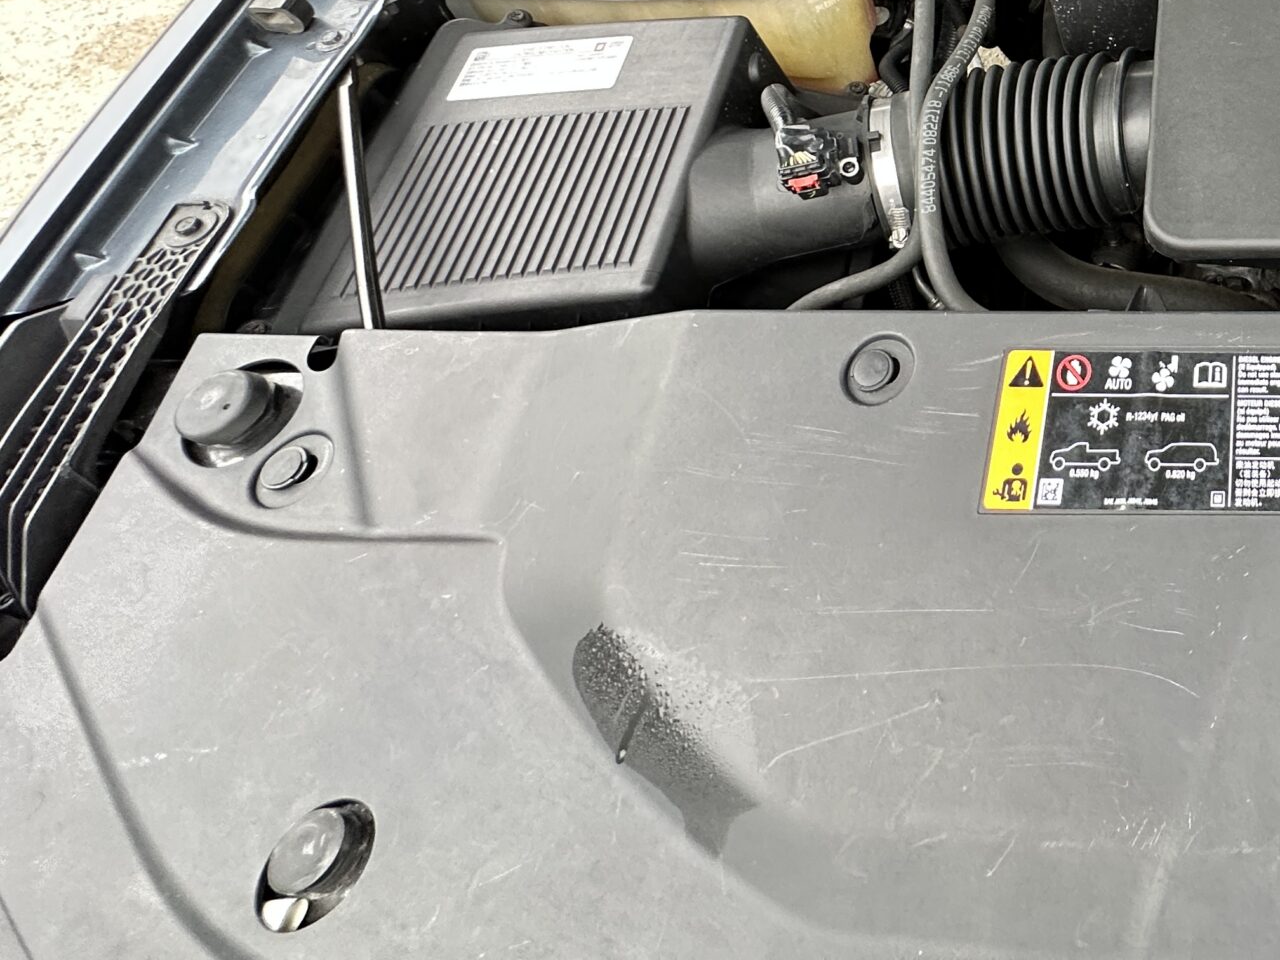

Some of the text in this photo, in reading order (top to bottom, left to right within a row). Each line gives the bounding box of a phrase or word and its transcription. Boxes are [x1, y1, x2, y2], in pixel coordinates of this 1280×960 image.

[922, 100, 942, 145] 082218
[920, 148, 937, 214] 84405474
[1104, 378, 1132, 390] AUTO
